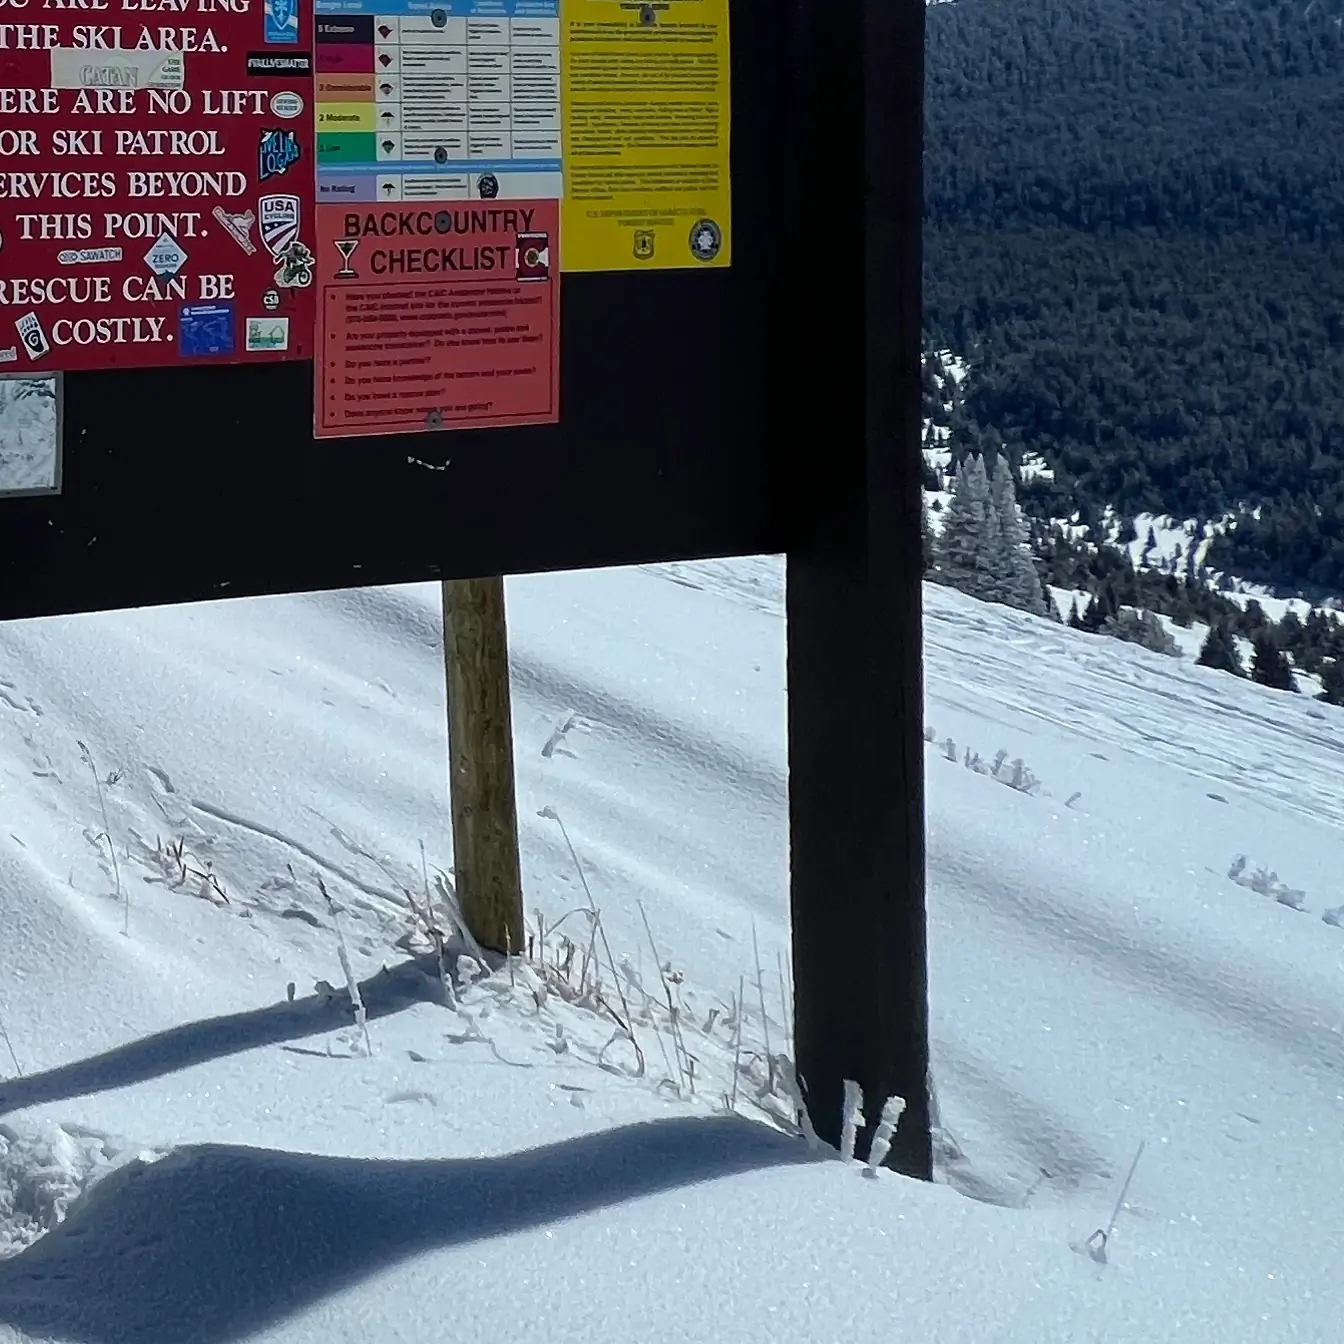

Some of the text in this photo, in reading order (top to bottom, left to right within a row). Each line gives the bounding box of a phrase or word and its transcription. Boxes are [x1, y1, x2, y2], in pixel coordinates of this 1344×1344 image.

[72, 25, 122, 51] SKI
[136, 26, 228, 53] AREA.
[79, 66, 139, 86] CATAN
[71, 89, 136, 114] ARE
[147, 89, 192, 115] NO
[201, 90, 268, 115] LIFT
[52, 130, 103, 155] SKI
[115, 130, 226, 155] PATROL
[127, 172, 247, 197] BEYOND
[264, 200, 295, 213] USA
[16, 213, 208, 239] THIS POINT.
[152, 254, 179, 264] ZERO
[370, 246, 511, 274] CHECKLIST
[122, 275, 187, 302] CAN
[198, 274, 235, 300] BE
[52, 317, 174, 345] COSTLY.
